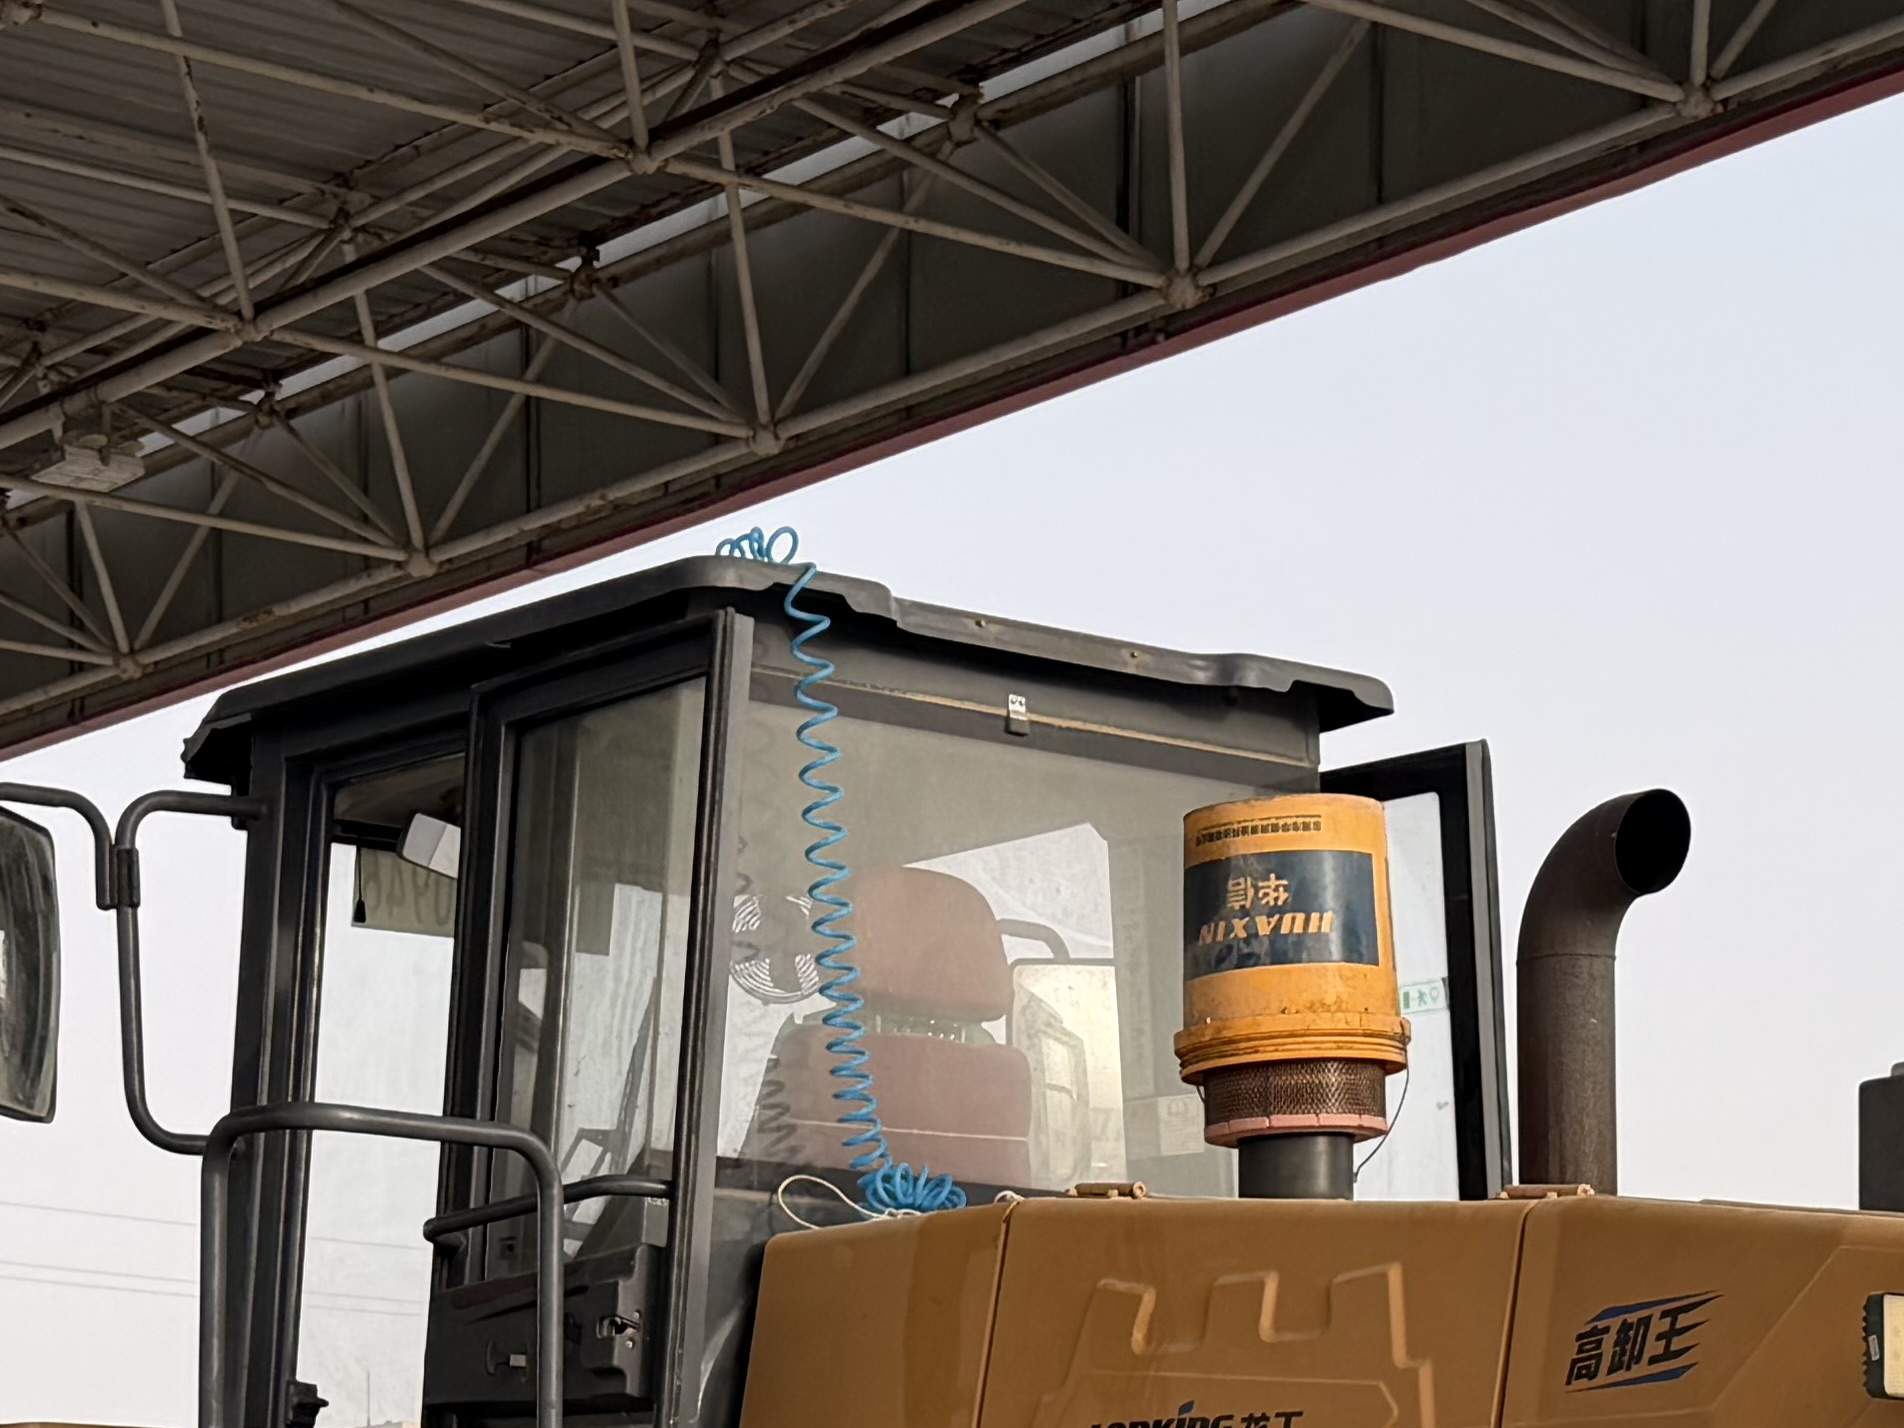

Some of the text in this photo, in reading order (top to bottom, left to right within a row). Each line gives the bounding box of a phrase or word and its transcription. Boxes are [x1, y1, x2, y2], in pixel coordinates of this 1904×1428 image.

[1226, 872, 1290, 909] 华信
[1199, 909, 1336, 947] HUAXIN
[1564, 1294, 1724, 1387] 高卸王
